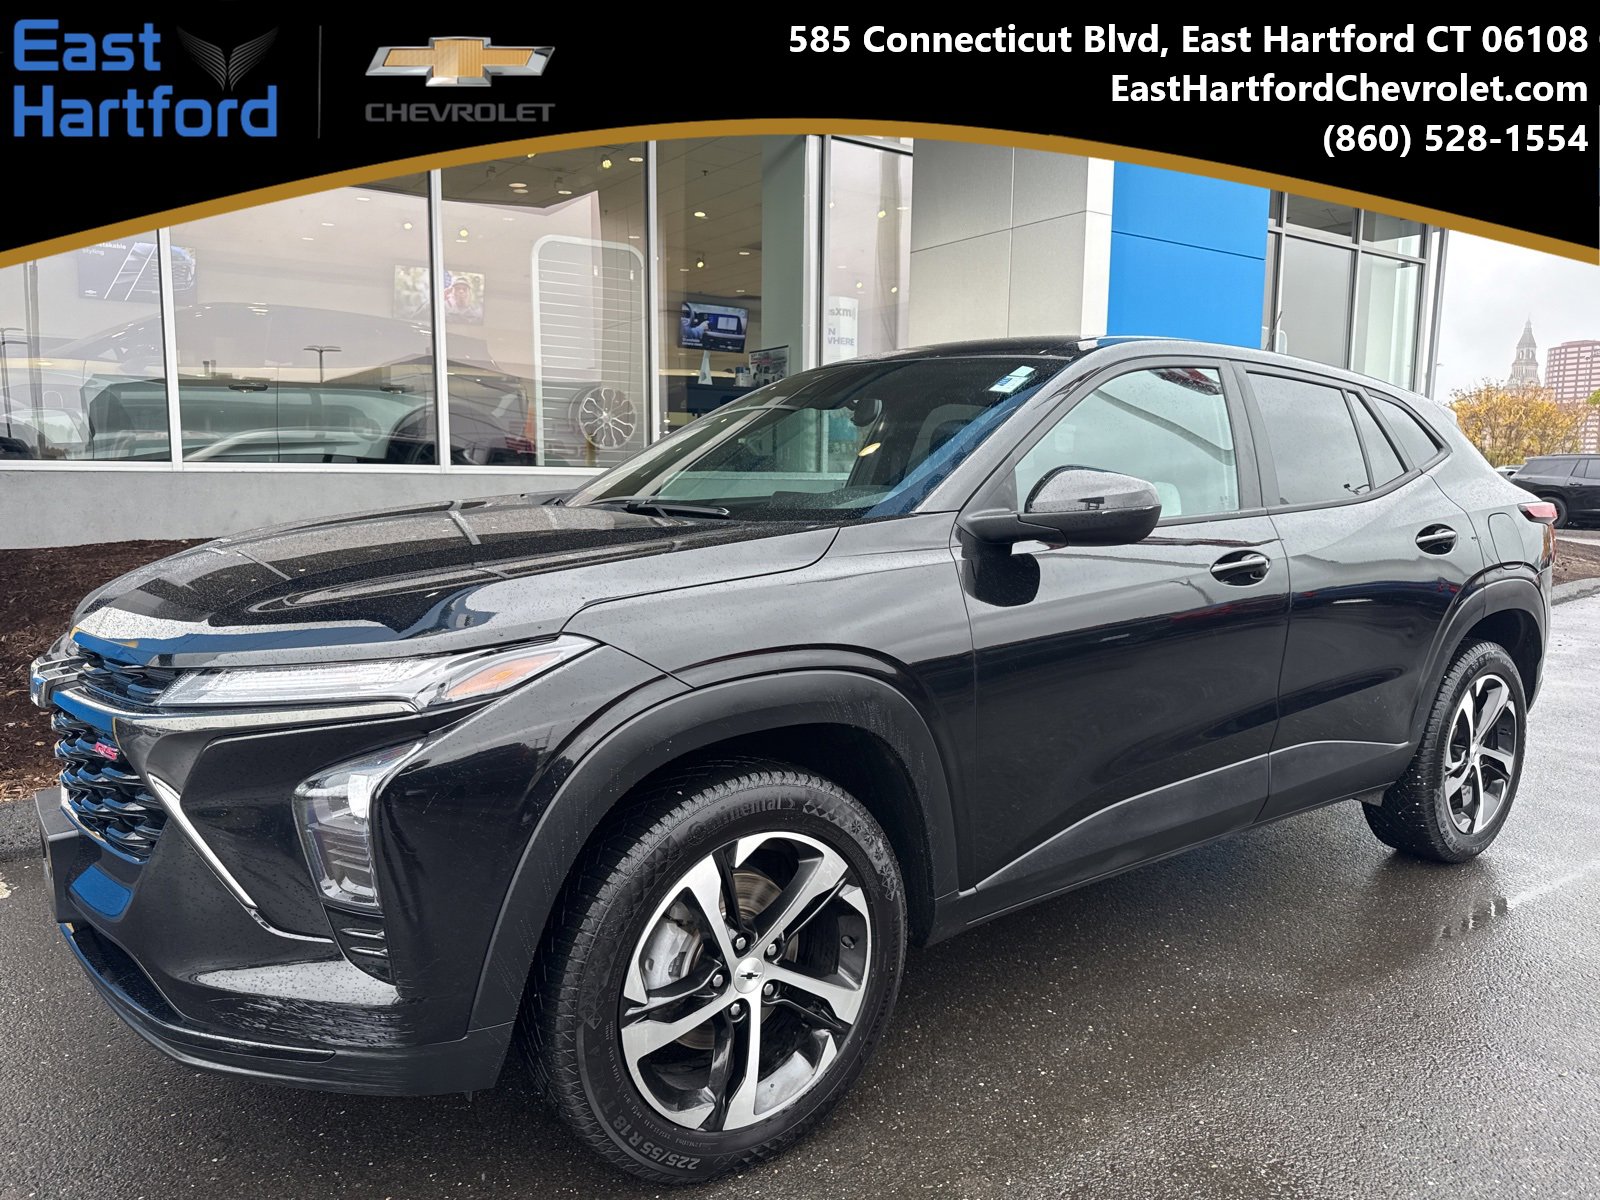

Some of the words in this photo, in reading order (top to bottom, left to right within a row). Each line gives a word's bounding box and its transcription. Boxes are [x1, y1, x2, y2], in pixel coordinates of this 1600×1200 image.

[95, 741, 119, 761] RS
[612, 1115, 633, 1137] 18
[628, 1131, 644, 1147] R
[639, 1141, 701, 1170] 225/55
